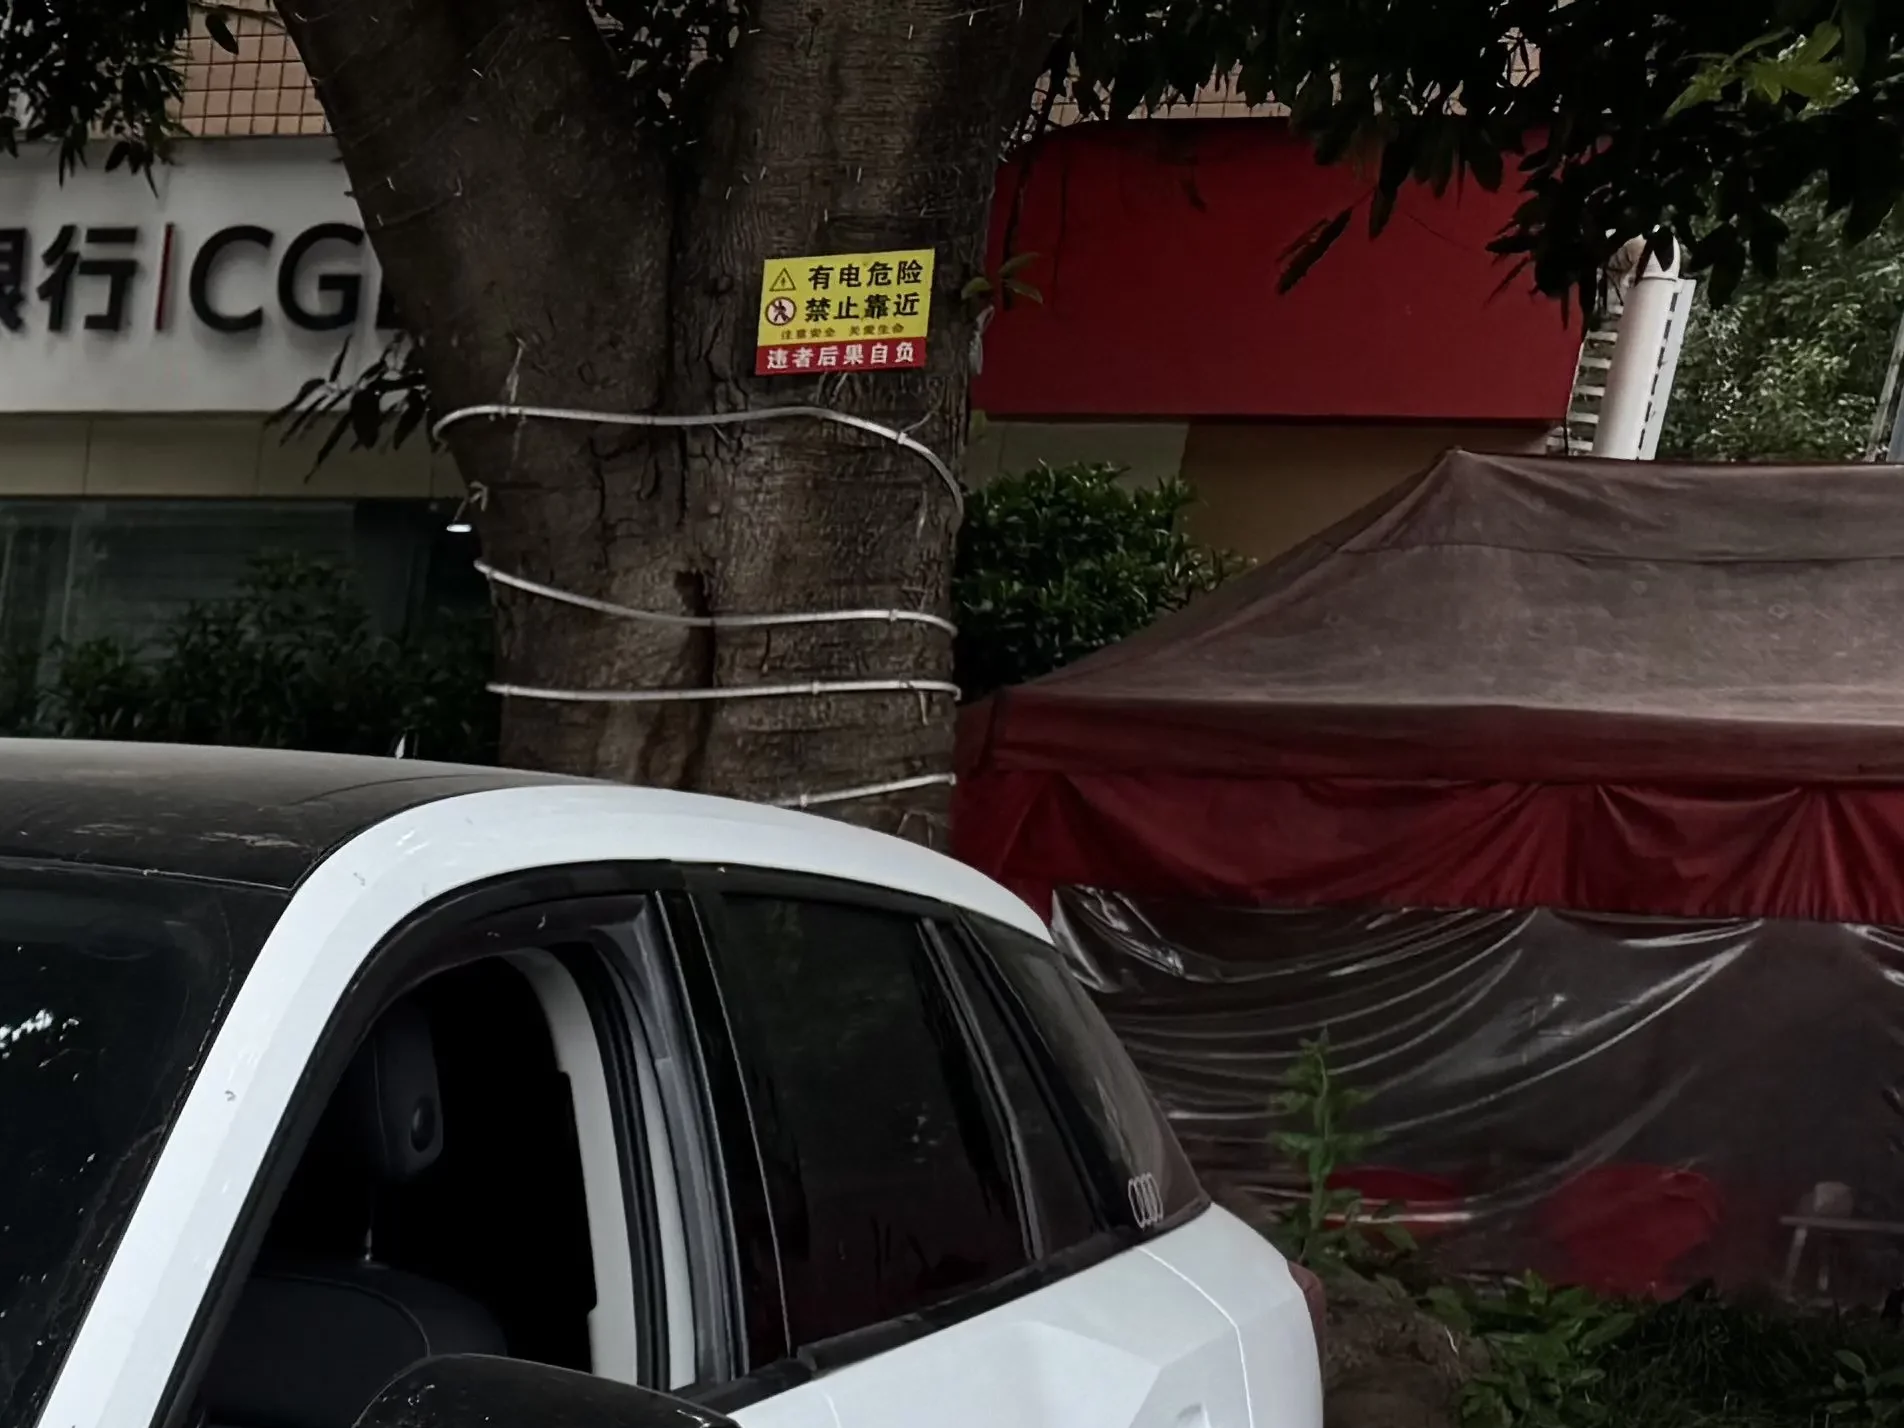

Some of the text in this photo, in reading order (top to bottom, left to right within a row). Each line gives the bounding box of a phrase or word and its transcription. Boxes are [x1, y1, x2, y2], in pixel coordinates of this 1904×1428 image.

[189, 222, 390, 333] CG
[808, 259, 923, 290] 有电危险
[805, 292, 920, 322] 禁止靠近
[767, 341, 914, 369] 违者后果自负
